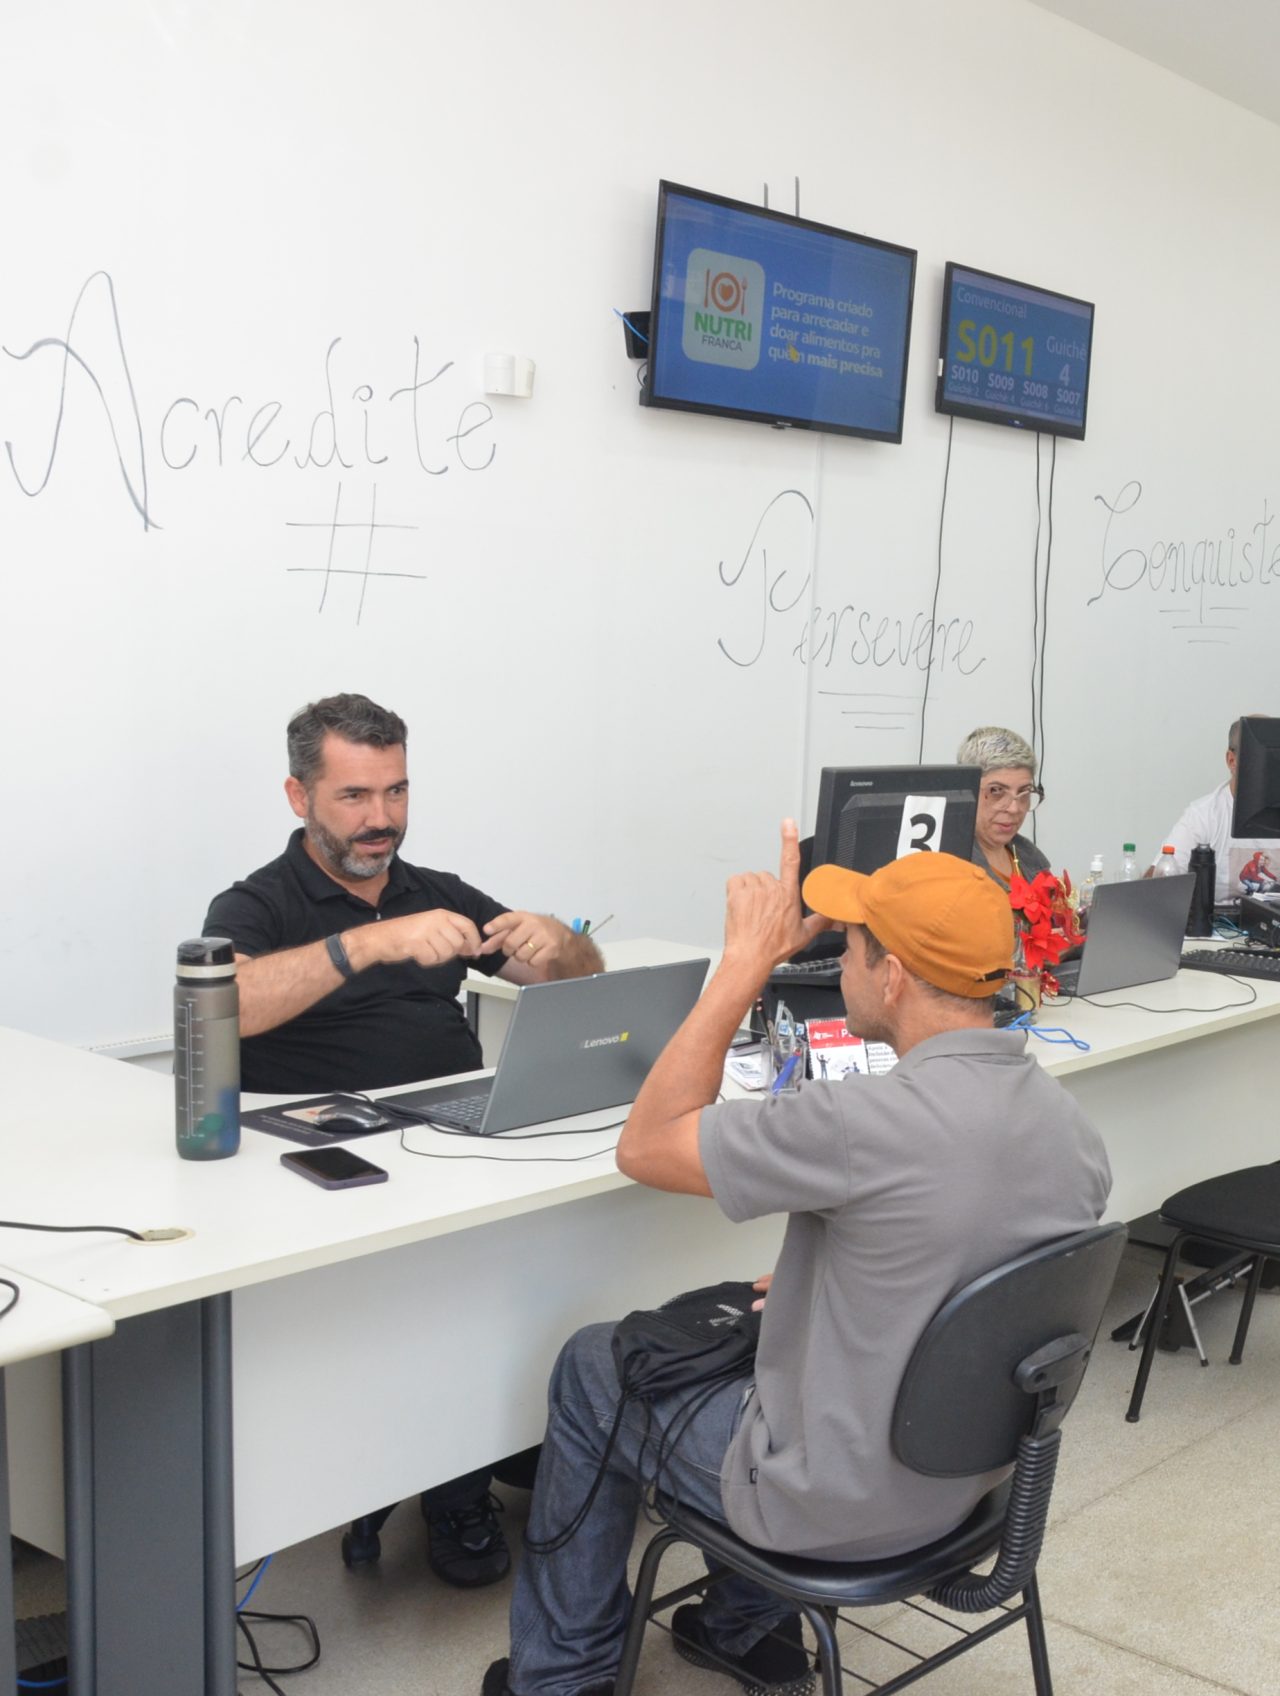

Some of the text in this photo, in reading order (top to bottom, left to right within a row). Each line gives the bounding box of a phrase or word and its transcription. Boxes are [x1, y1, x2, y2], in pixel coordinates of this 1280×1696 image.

[773, 281, 873, 318] Programa criado
[956, 287, 1027, 319] Convencional
[694, 311, 752, 342] NUTRI
[771, 306, 870, 337] para arrecadar e
[770, 322, 881, 360] doar alimentos pra
[956, 318, 1034, 378] S011
[1046, 335, 1089, 360] Guichê
[807, 353, 838, 369] mais
[840, 359, 883, 378] precisa
[951, 364, 979, 383] S010
[1060, 363, 1070, 386] 4
[988, 373, 1014, 391] S009
[1023, 380, 1048, 399] S008
[1056, 388, 1080, 404] S007
[2, 269, 498, 532] Acredite
[717, 489, 987, 675] Persevere
[910, 813, 936, 852] 3
[584, 1035, 619, 1048] Lenovo
